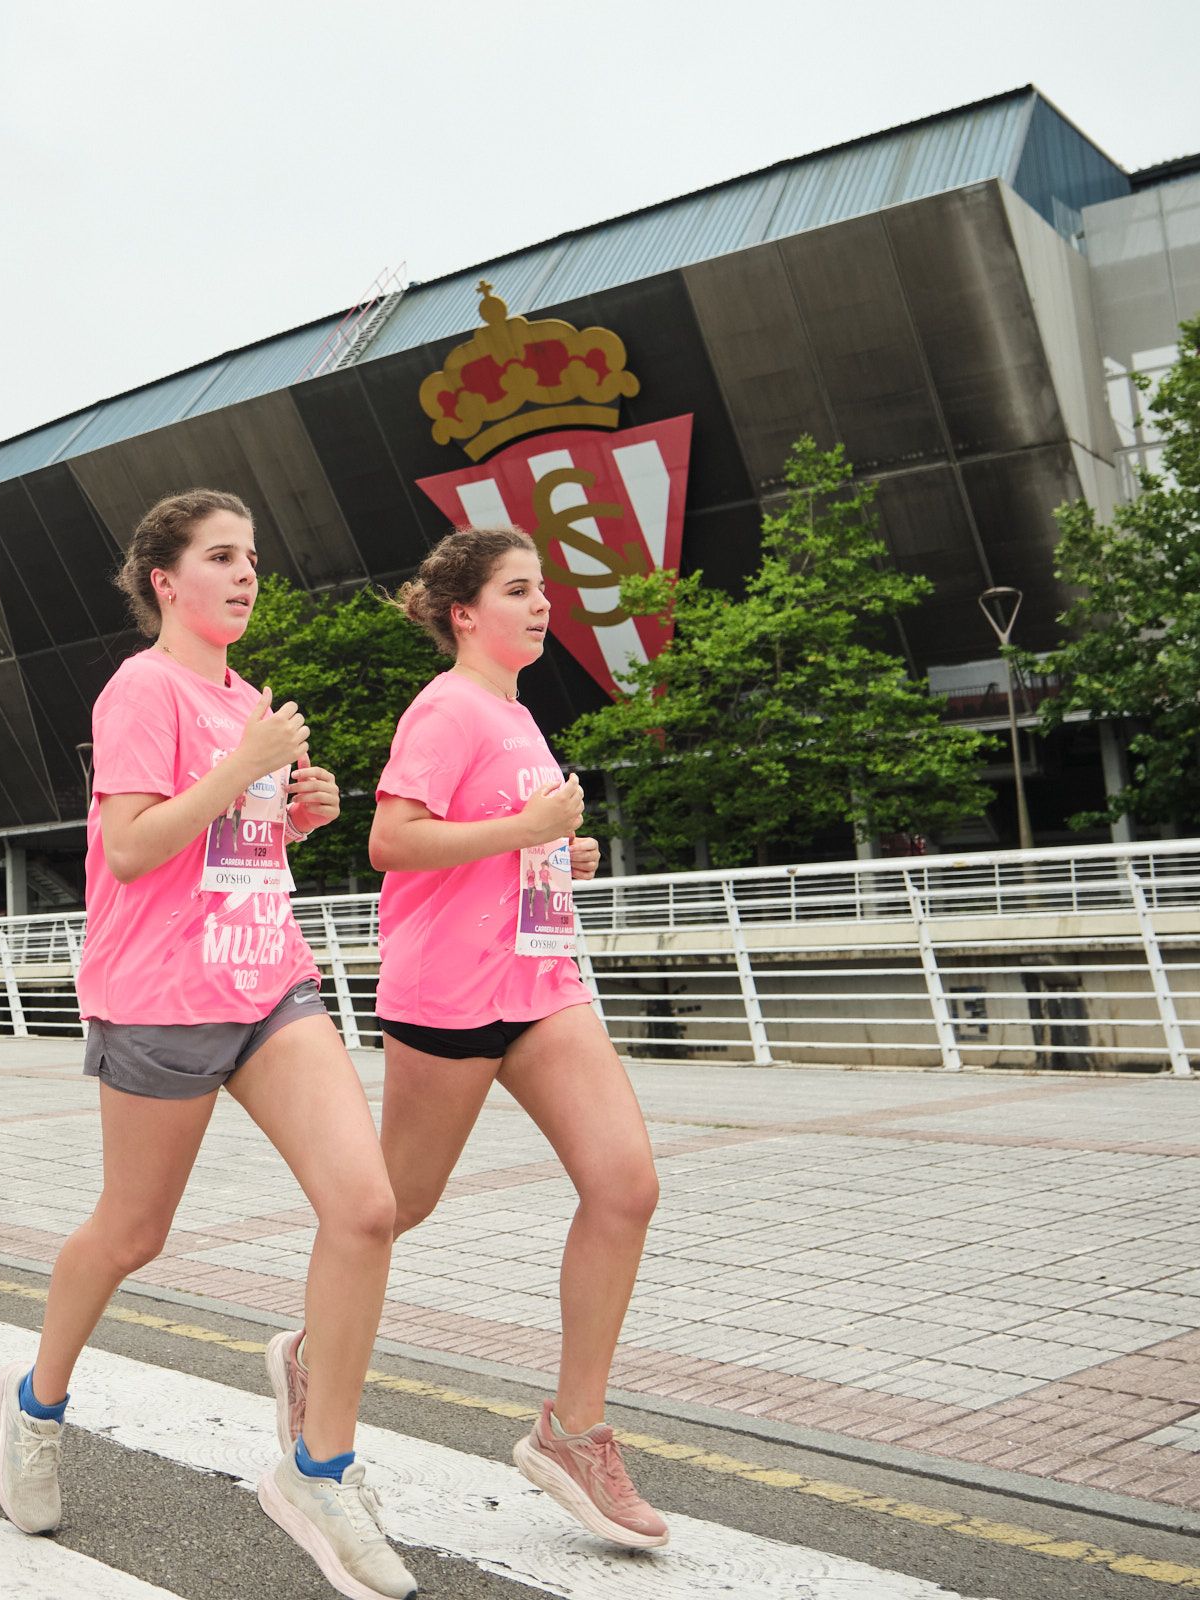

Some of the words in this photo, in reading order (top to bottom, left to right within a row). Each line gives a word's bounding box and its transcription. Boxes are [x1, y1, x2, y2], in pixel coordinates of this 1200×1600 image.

[503, 736, 532, 750] OYS
[254, 847, 267, 857] 129
[220, 858, 244, 867] CARRERA
[245, 859, 252, 867] DE
[216, 874, 251, 884] OYSHO
[203, 925, 286, 965] MUJER
[530, 939, 557, 949] OYSHO
